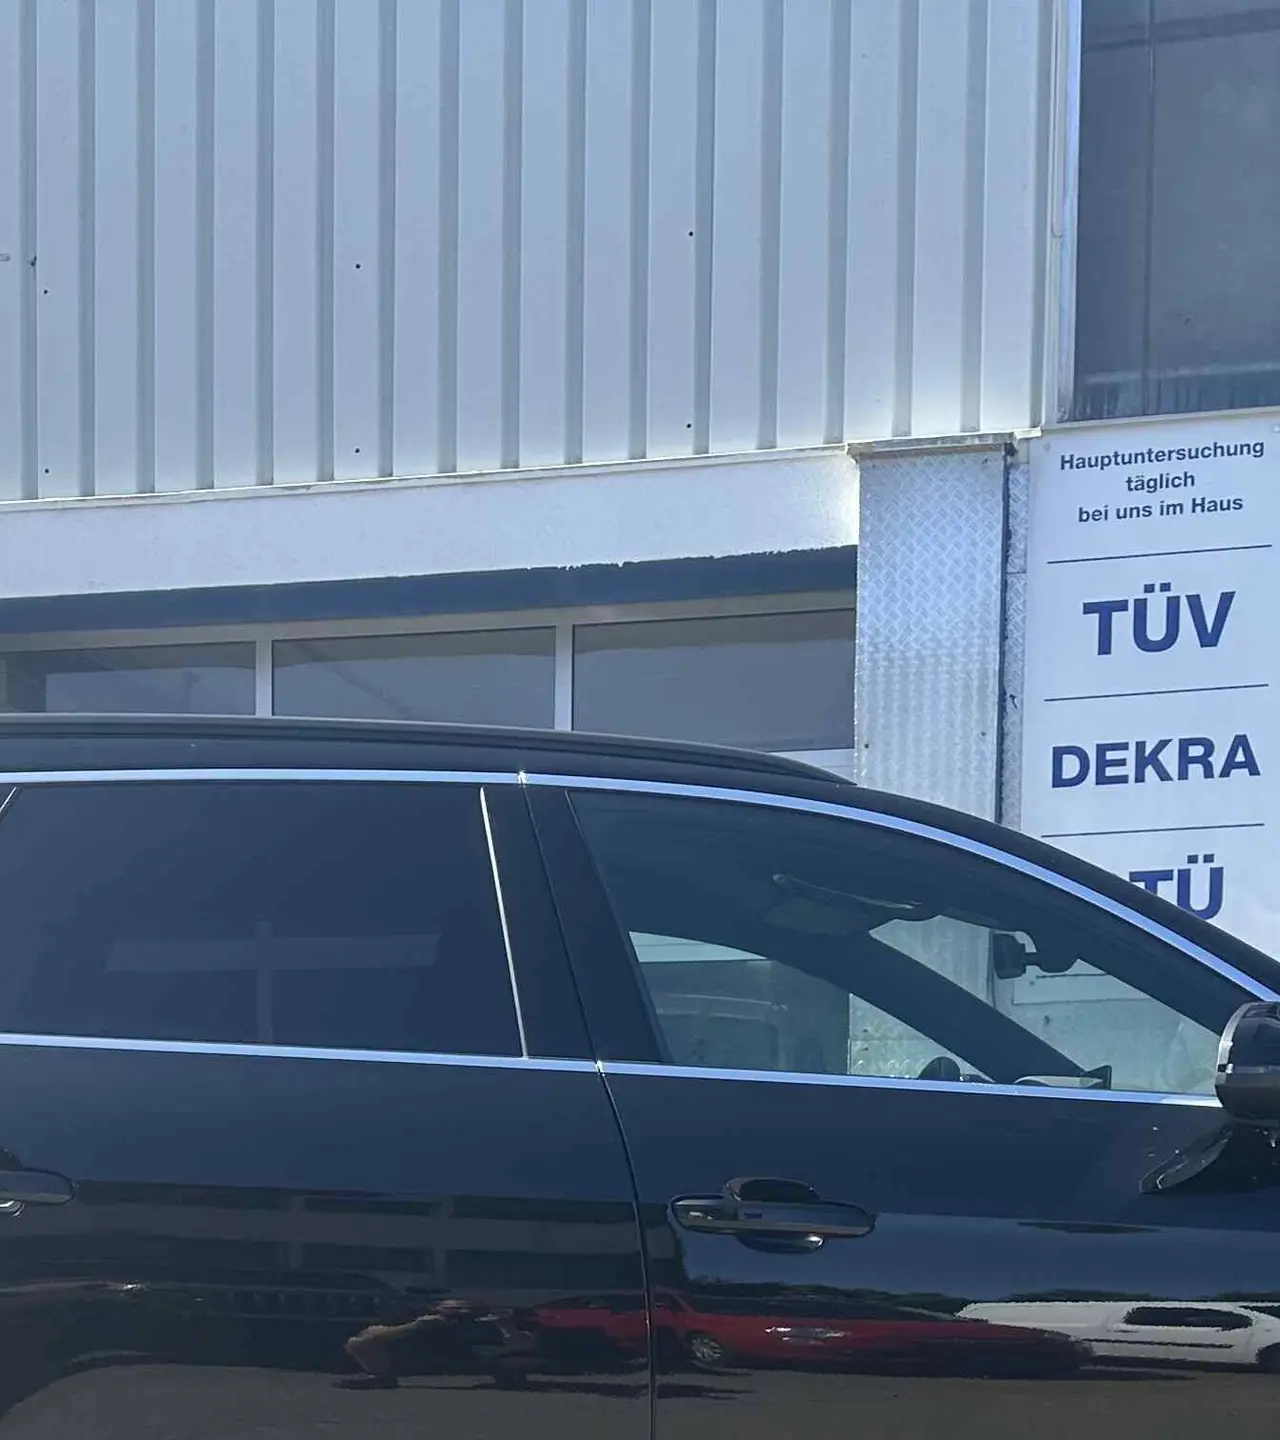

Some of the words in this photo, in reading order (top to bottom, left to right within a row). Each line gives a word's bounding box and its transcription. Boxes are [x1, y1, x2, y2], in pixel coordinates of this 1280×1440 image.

[1060, 441, 1265, 470] Hauptuntersuchung
[1125, 471, 1195, 494] täglich
[1078, 505, 1109, 523] bei
[1116, 504, 1153, 519] uns
[1159, 500, 1184, 516] im
[1191, 496, 1244, 514] Haus
[1082, 582, 1236, 656] TÜV
[1051, 733, 1261, 788] DEKRA
